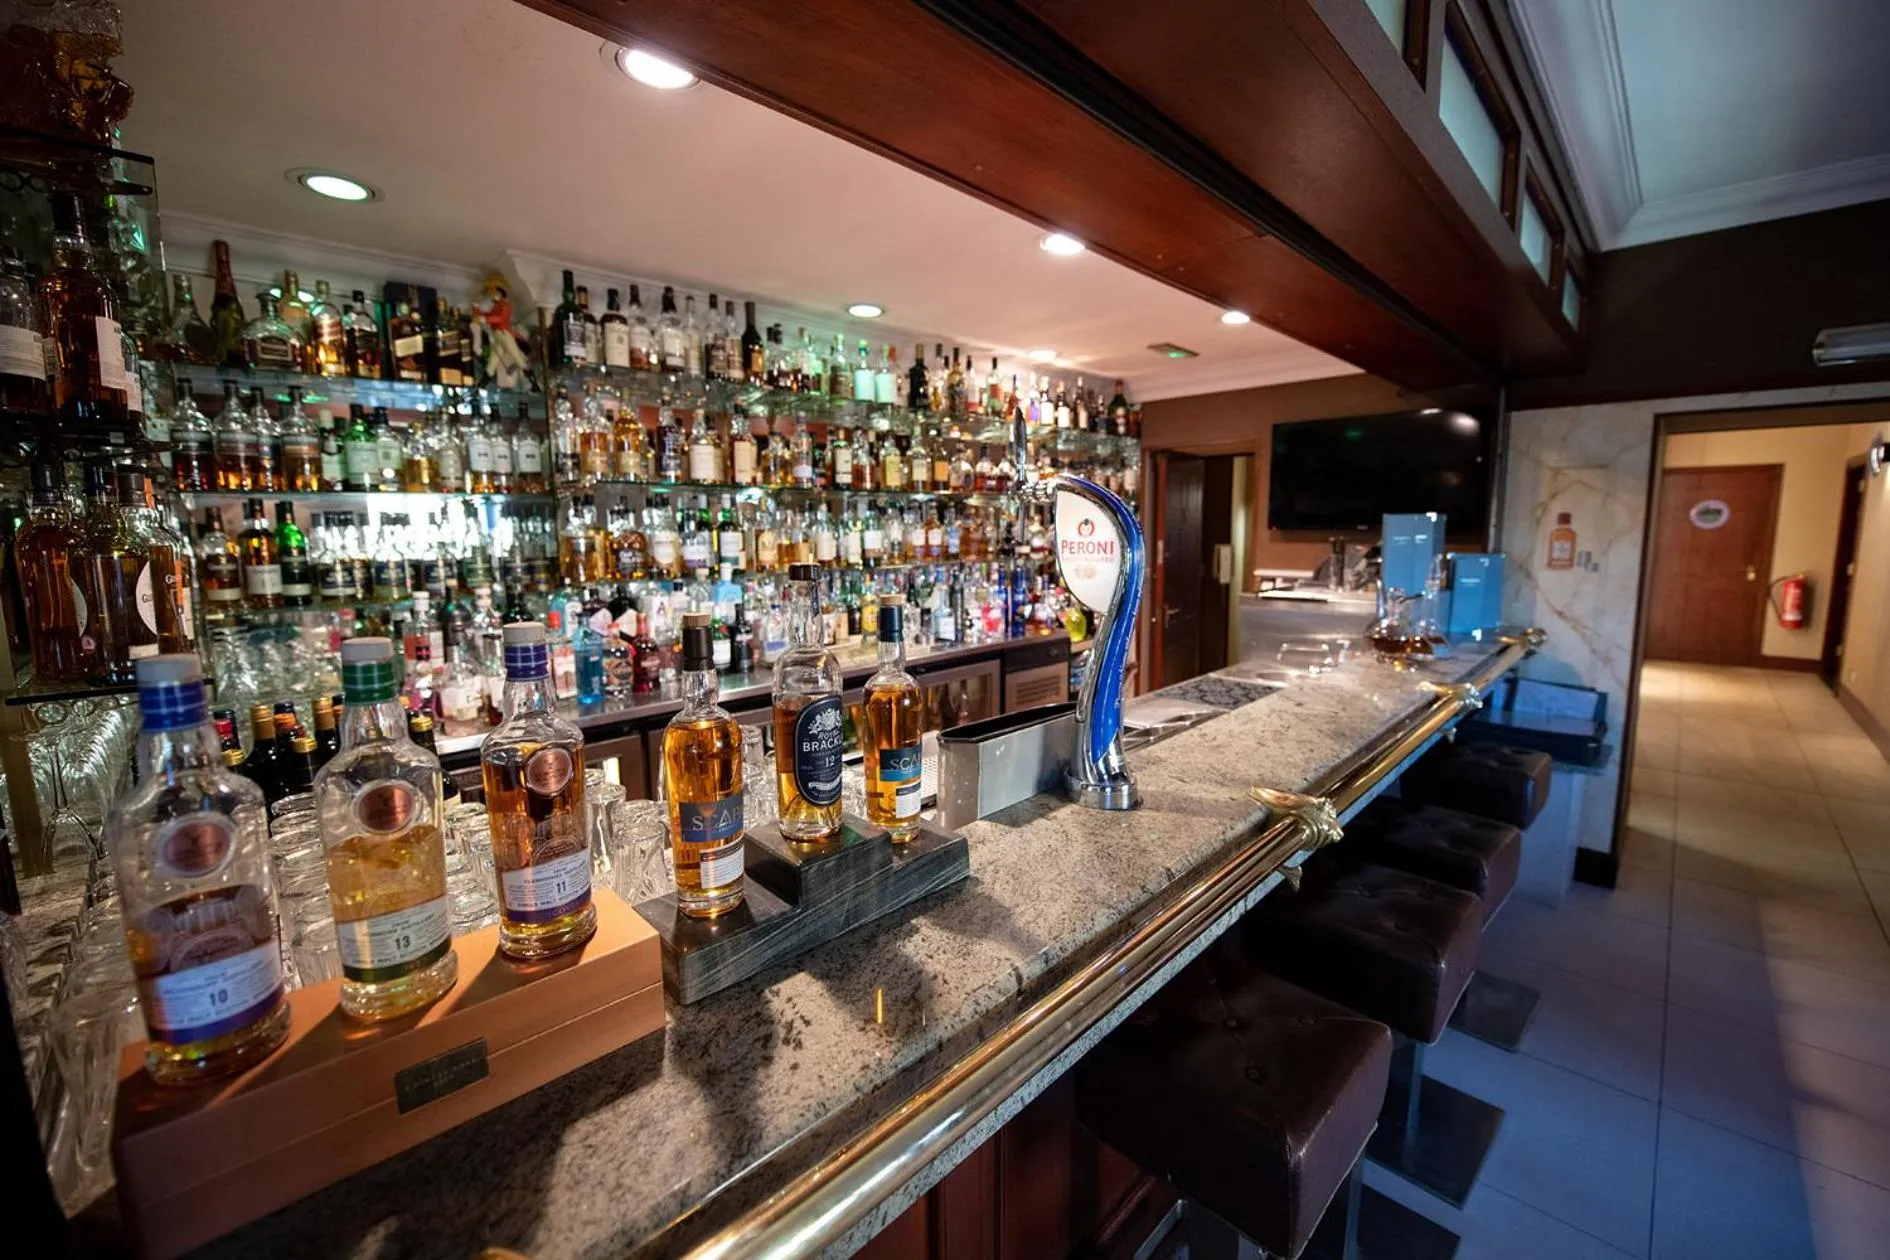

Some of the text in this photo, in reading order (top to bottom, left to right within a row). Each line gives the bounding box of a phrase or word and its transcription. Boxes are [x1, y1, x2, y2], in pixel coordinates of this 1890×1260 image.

[1061, 540, 1114, 555] PERONI
[825, 755, 835, 768] 12
[557, 881, 567, 894] 11
[396, 935, 411, 950] 13
[209, 988, 228, 1007] 10
